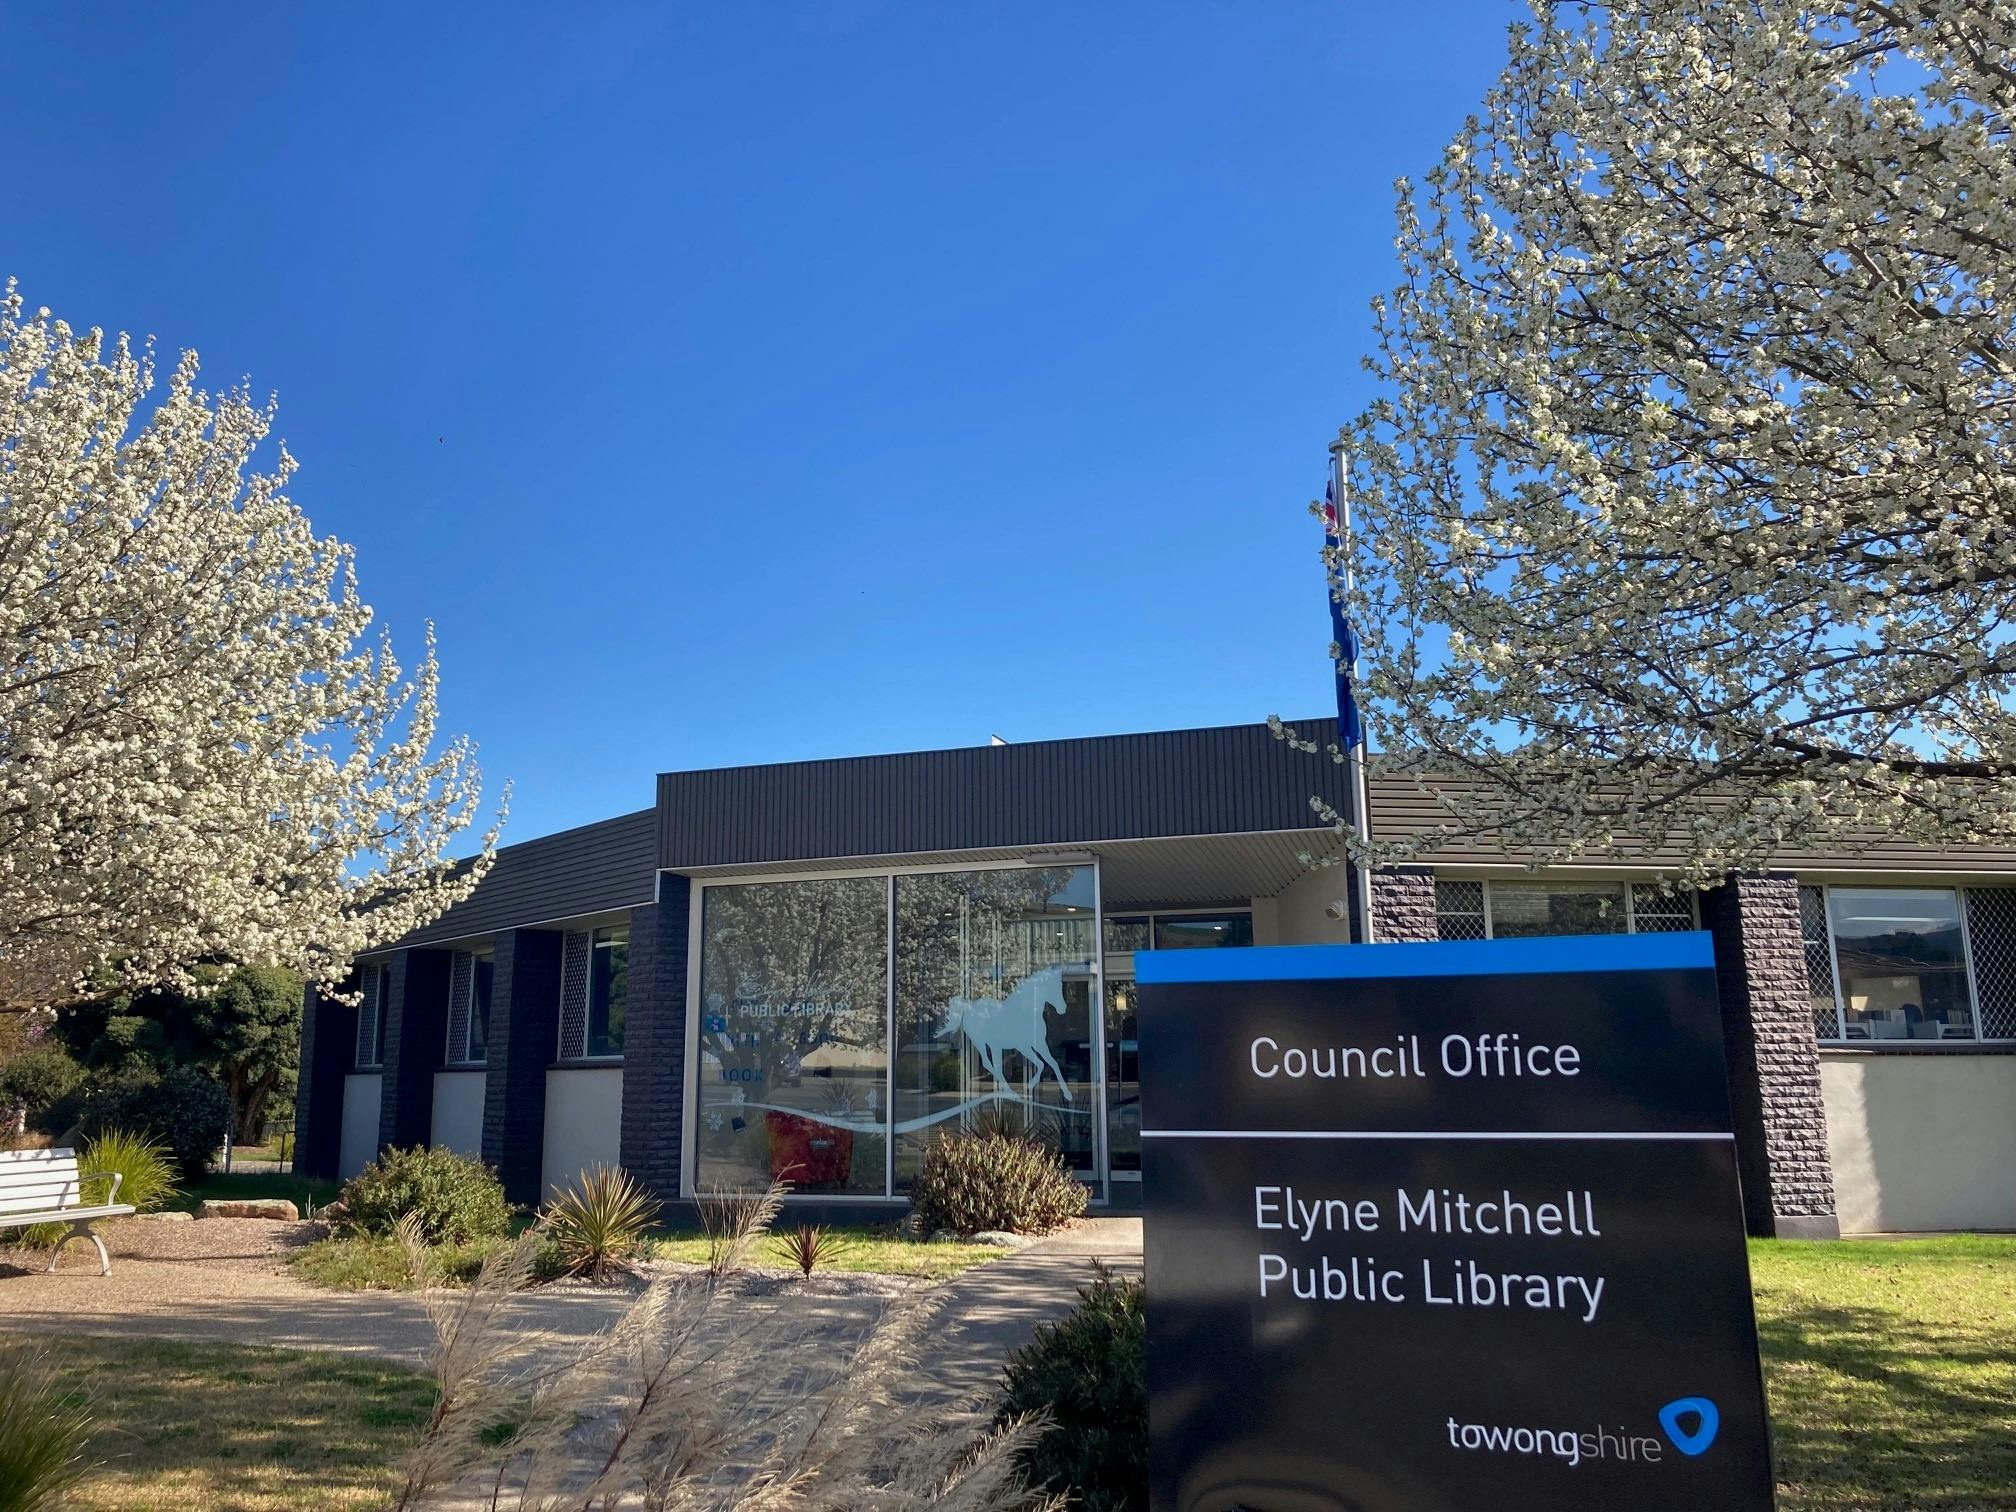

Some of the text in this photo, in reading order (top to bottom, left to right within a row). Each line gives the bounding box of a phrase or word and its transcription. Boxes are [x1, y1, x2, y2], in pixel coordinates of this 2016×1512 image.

[740, 1001, 790, 1018] PUBLIC
[794, 999, 852, 1018] LIBRARY
[1250, 1033, 1581, 1079] Council Office
[1254, 1186, 1601, 1242] Elyne Mitchell
[1258, 1254, 1606, 1322] Public Library
[1446, 1417, 1662, 1467] towongshire
